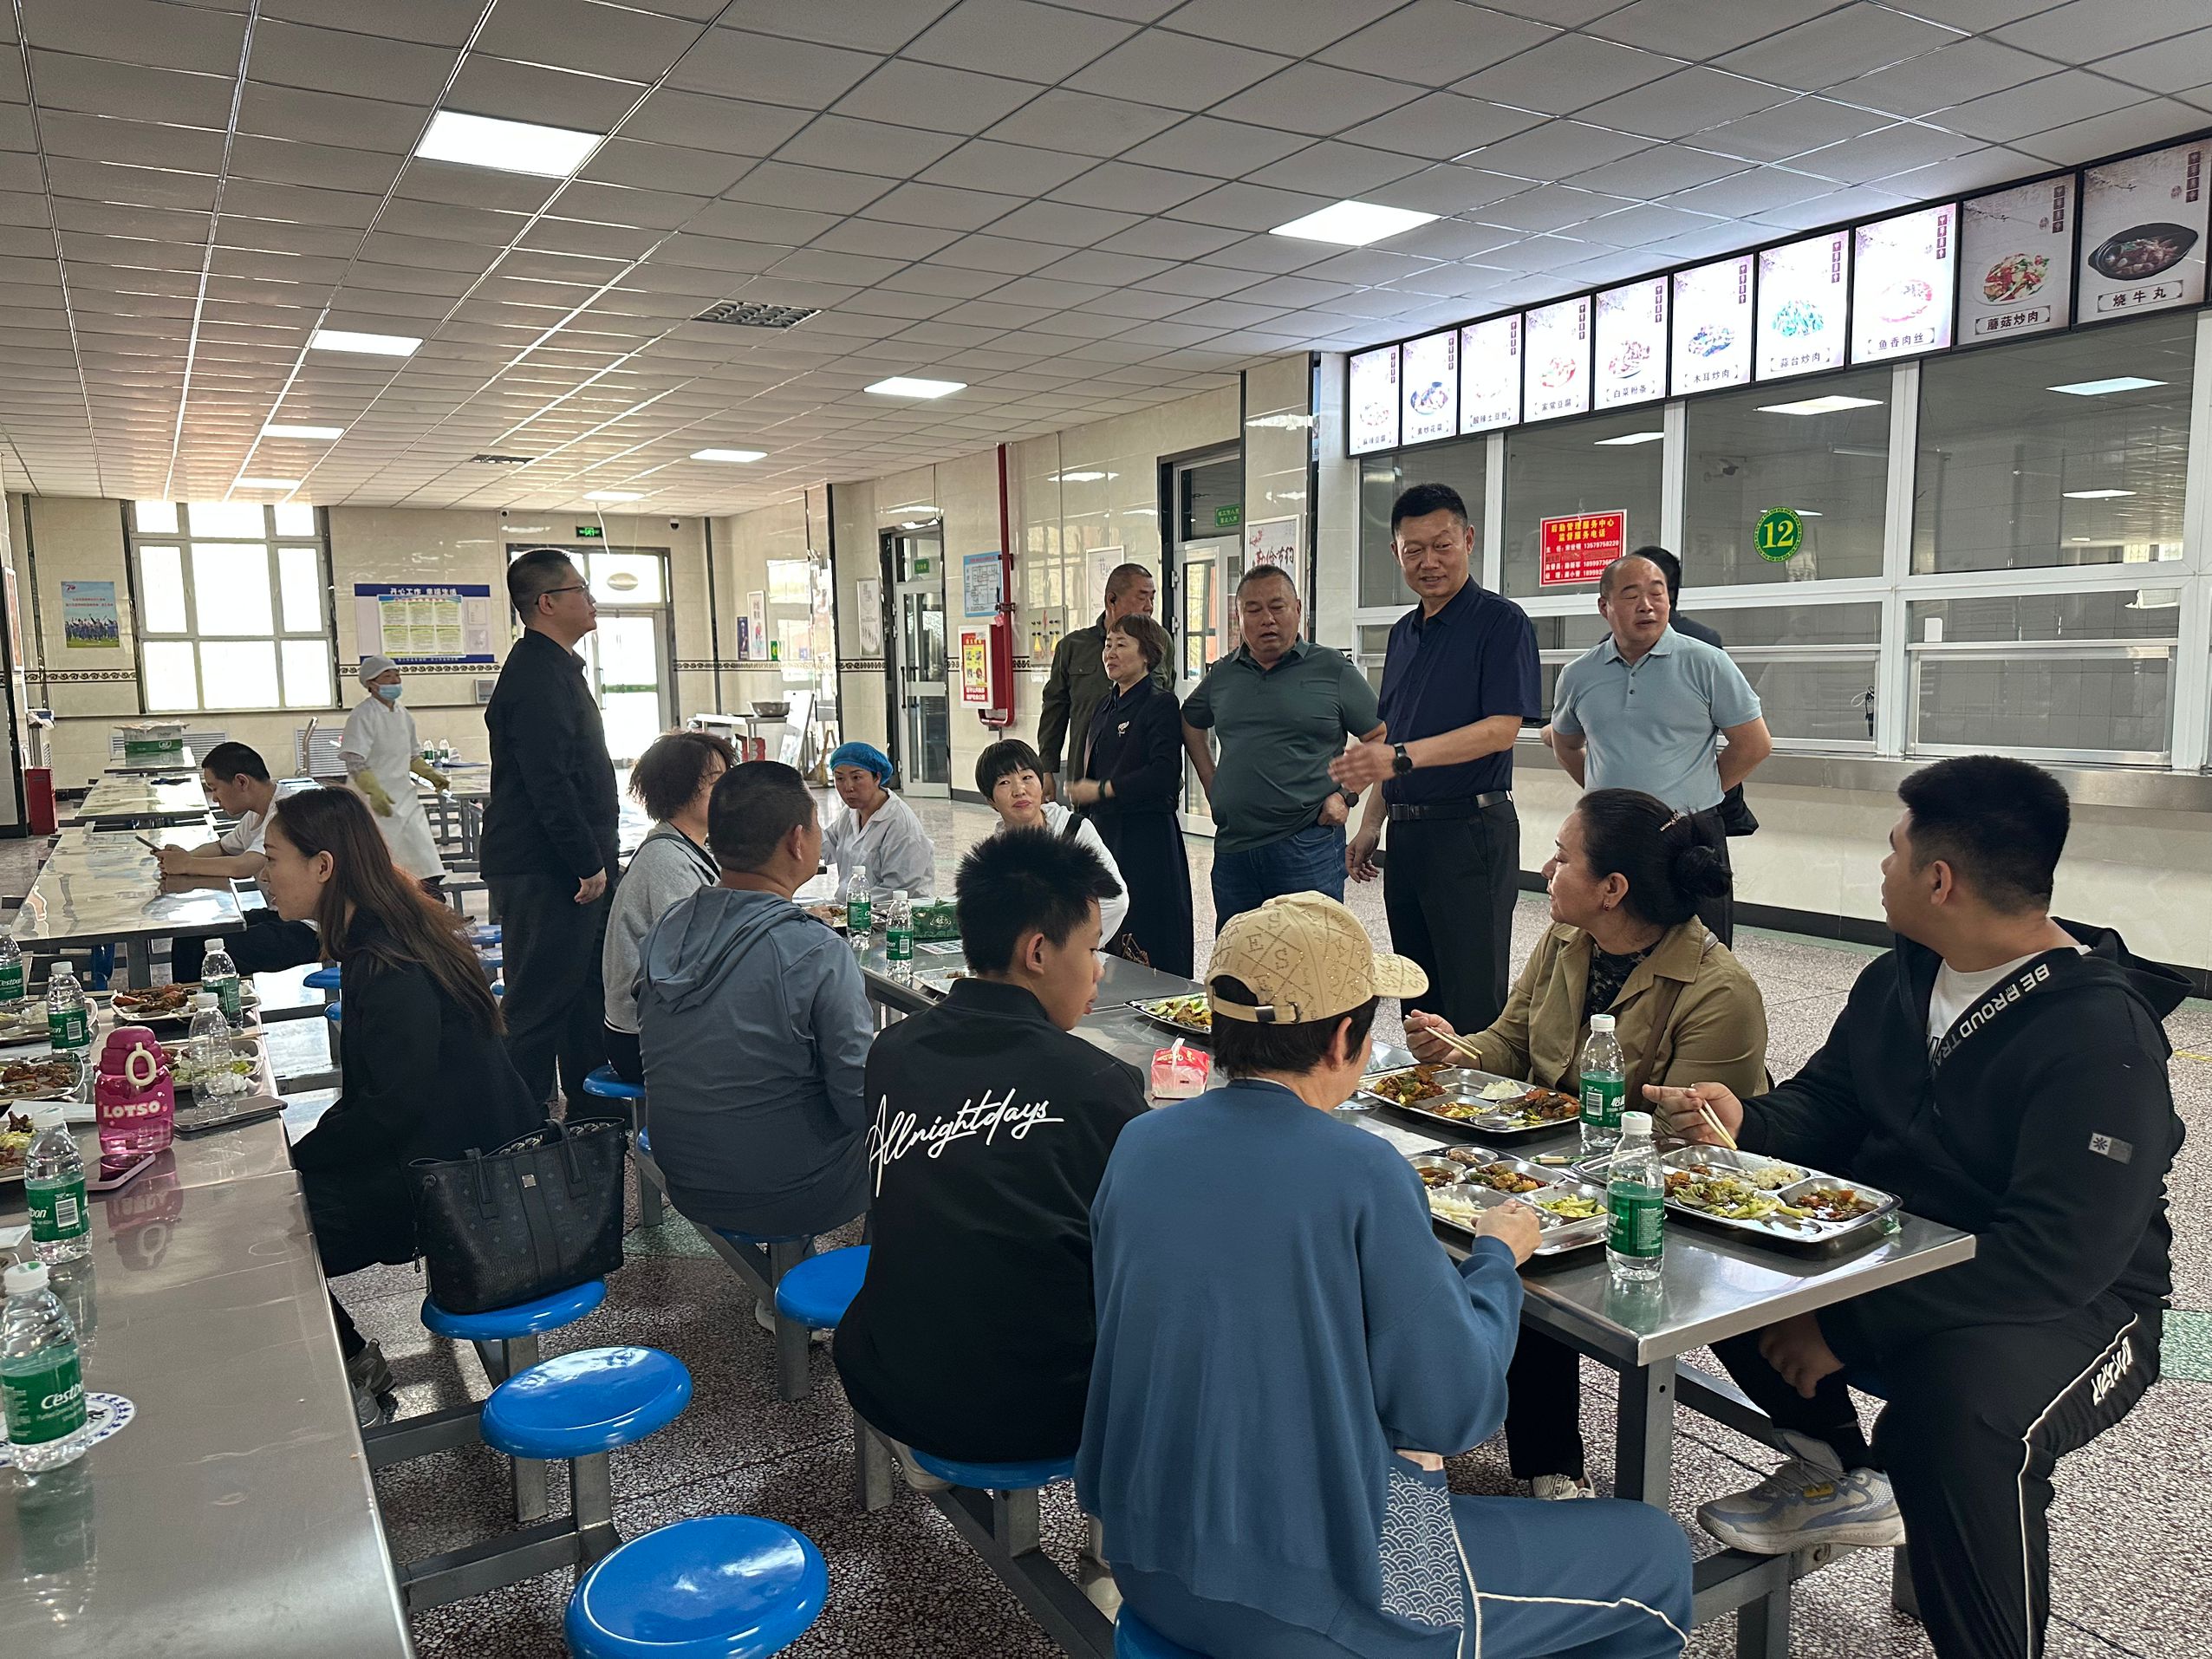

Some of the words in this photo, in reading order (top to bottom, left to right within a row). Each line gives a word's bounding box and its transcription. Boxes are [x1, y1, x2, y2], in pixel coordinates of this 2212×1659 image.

[2112, 286, 2167, 307] 烧牛丸
[1987, 310, 2039, 330] 蘑菇炒肉
[1878, 333, 1923, 350] 鱼香肉丝
[1779, 351, 1820, 368] 蒜台炒肉
[1693, 368, 1730, 383] 木耳炒肉
[1551, 518, 1614, 532] 后勤管理服务中心
[1763, 520, 1794, 548] 12
[1558, 528, 1606, 542] 监督服务电话
[2020, 963, 2051, 992] BE
[1959, 983, 2021, 1038] PROUD
[103, 1100, 160, 1118] LOTSO
[865, 1088, 1064, 1198] Allnightdays
